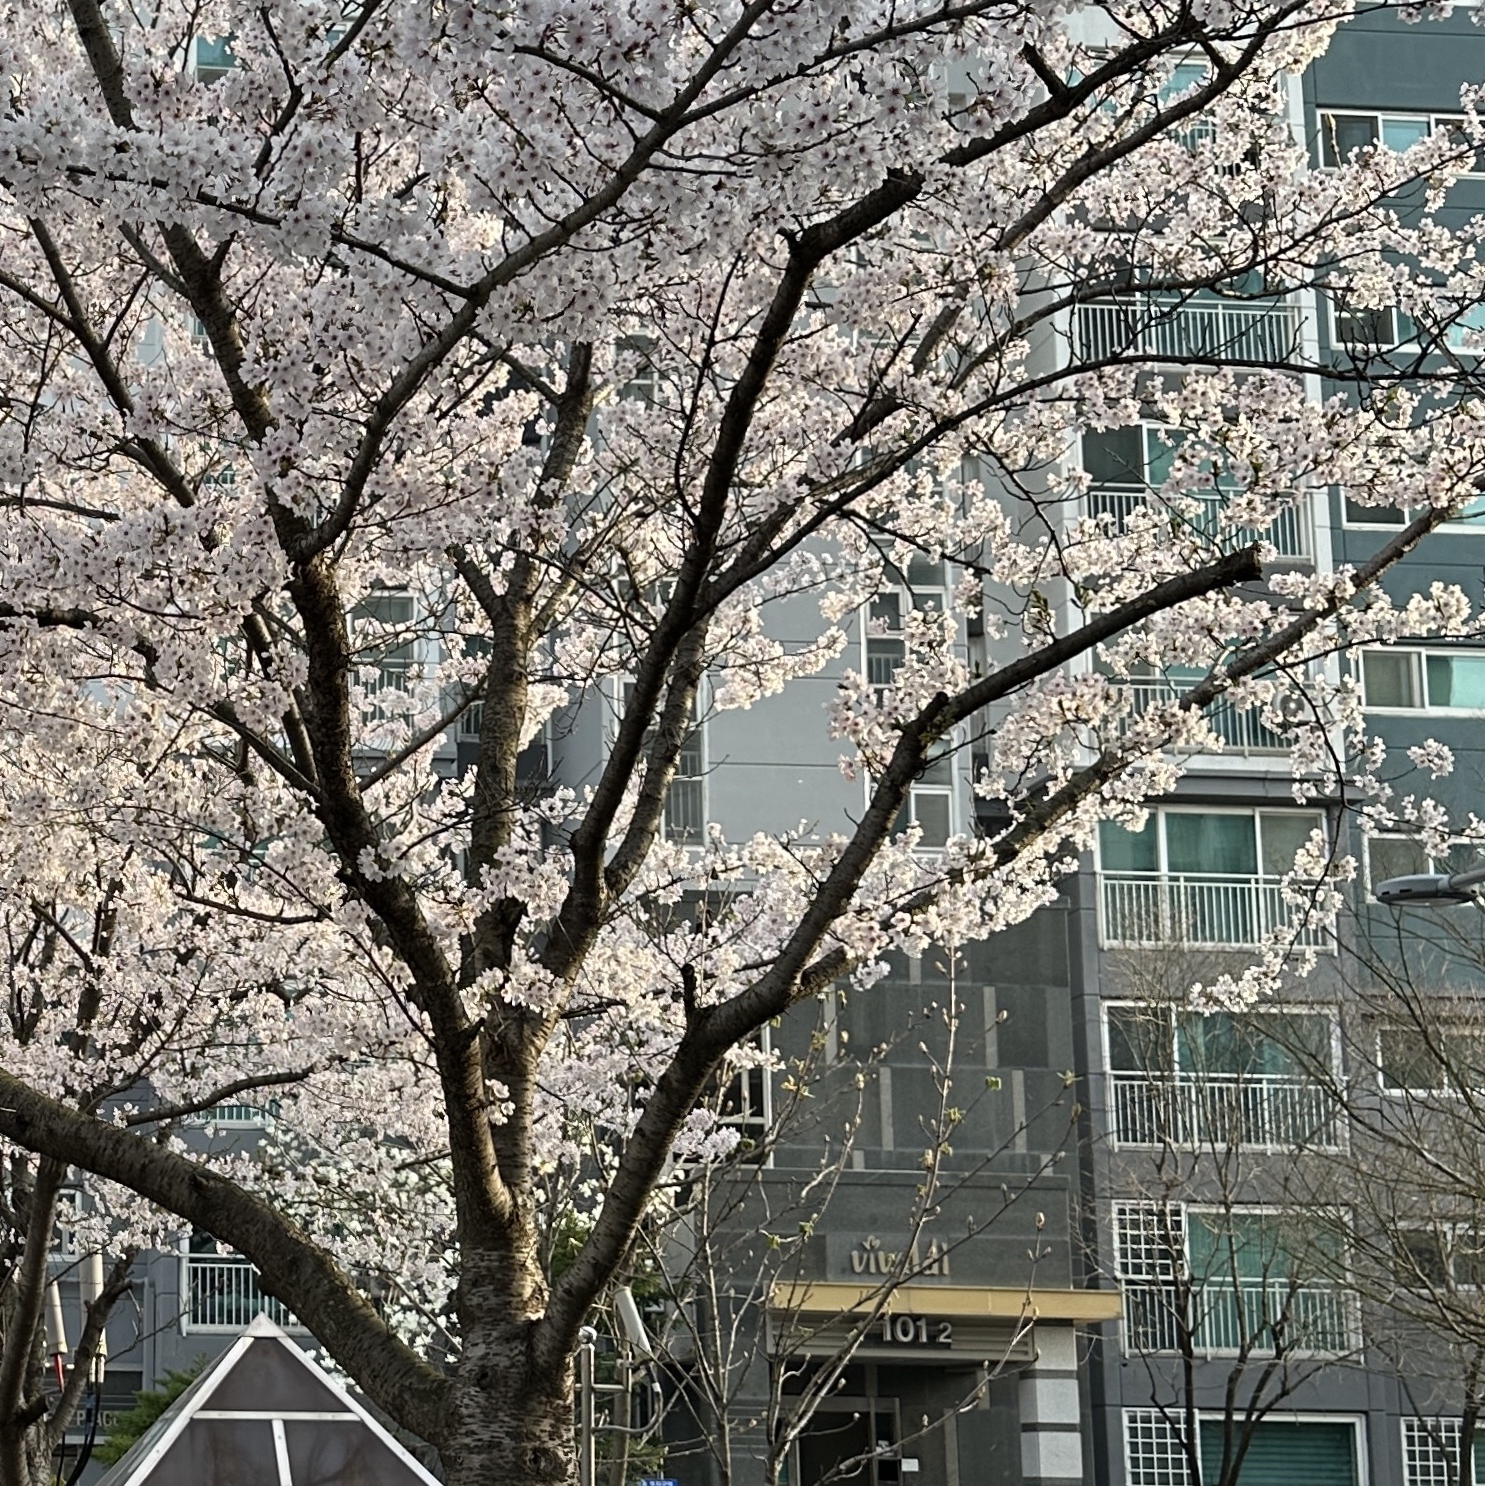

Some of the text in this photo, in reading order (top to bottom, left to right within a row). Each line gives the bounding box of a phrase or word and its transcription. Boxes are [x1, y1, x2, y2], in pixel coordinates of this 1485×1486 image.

[882, 1315, 953, 1343] 101 2
[76, 1410, 119, 1427] PAC
